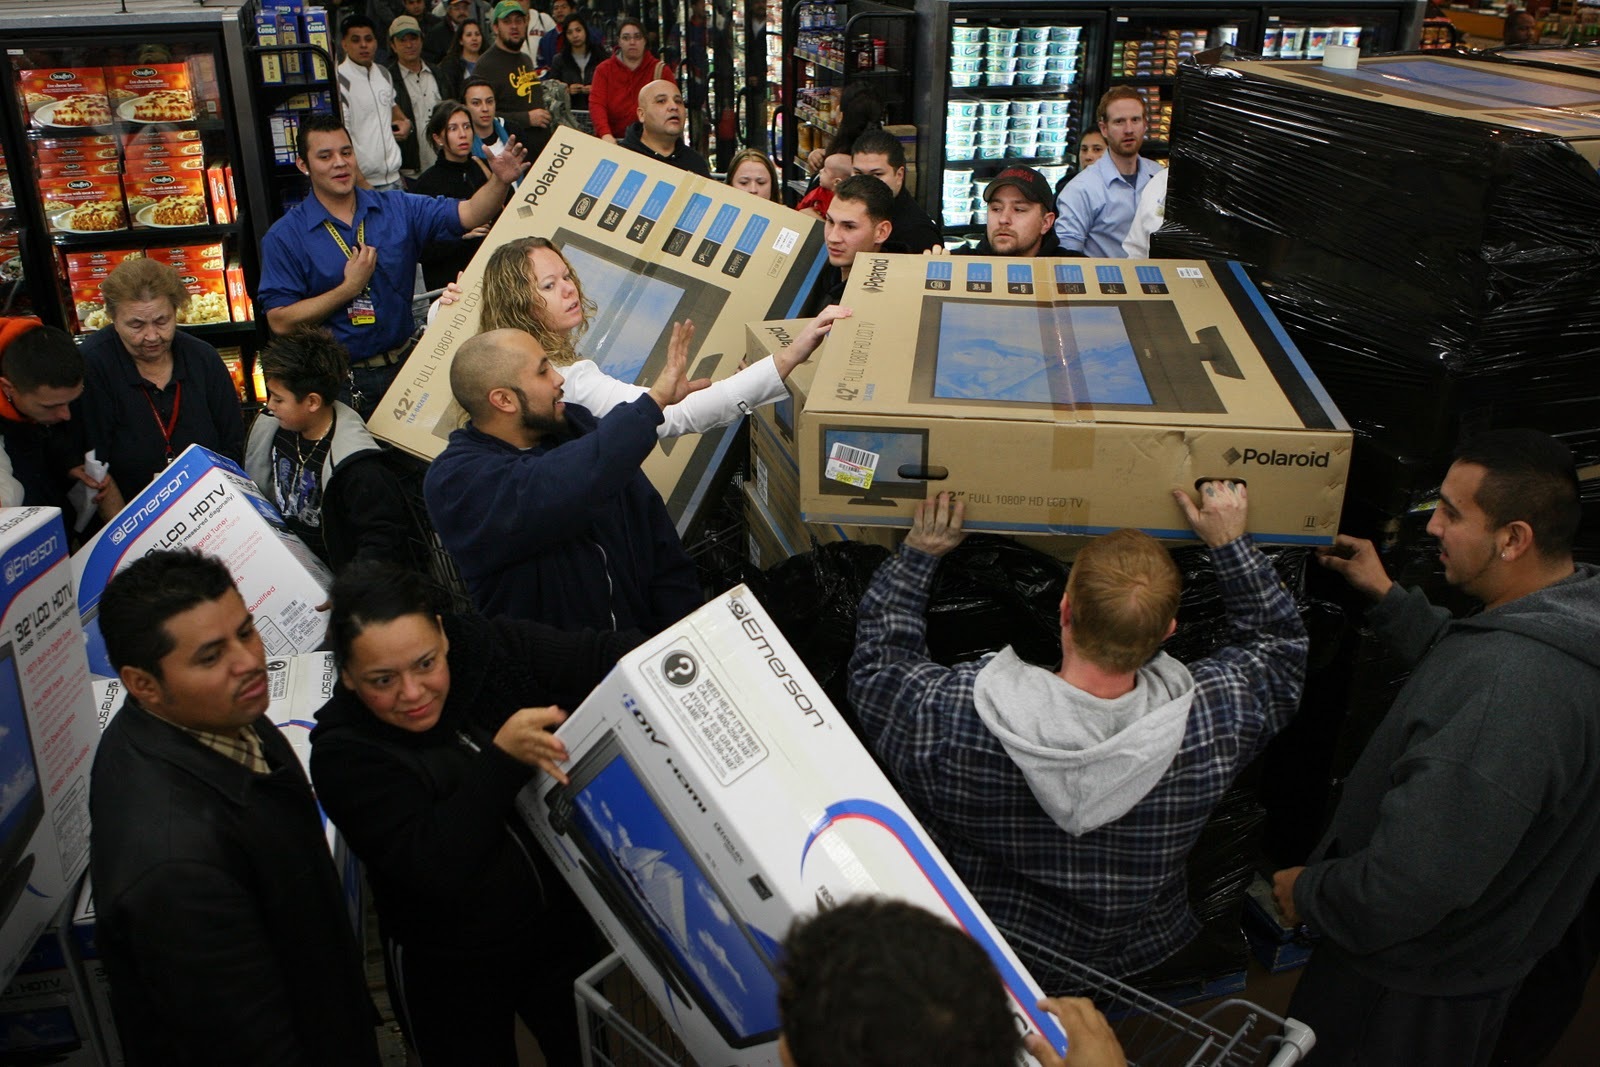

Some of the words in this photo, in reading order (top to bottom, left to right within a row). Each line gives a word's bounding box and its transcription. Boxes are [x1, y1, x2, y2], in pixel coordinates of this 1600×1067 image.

[524, 143, 574, 206] Polaroid
[863, 258, 890, 288] Polaroid
[856, 329, 874, 341] LCD
[858, 320, 876, 328] TV
[392, 388, 414, 421] 42"
[413, 364, 436, 388] FULL
[430, 330, 456, 361] 1080P
[450, 313, 467, 330] HD
[464, 292, 480, 314] LCD
[849, 349, 869, 366] 1080P
[843, 368, 864, 382] FULL
[835, 382, 859, 401] 42"
[1242, 448, 1330, 468] Polaroid
[124, 468, 190, 534] Emerson
[968, 493, 992, 504] FULL
[996, 495, 1026, 506] 1080P
[1028, 496, 1044, 506] HD
[1046, 496, 1066, 508] LCD
[1070, 498, 1083, 508] TV
[160, 522, 187, 548] LCD
[188, 484, 226, 522] HDTV
[184, 518, 208, 542] measured
[211, 518, 228, 534] Tuner
[13, 535, 58, 578] Emerson
[32, 600, 51, 628] LCD
[52, 580, 73, 612] HDTV
[247, 586, 276, 613] Qualified
[321, 660, 334, 698] Emerson
[742, 618, 824, 728] Emerson
[680, 694, 702, 721] LLAME
[688, 691, 714, 721] AYUDA?
[696, 683, 713, 706] CALL
[704, 678, 722, 699] NEED
[719, 697, 738, 720] HELP?
[98, 688, 119, 730] Emerson
